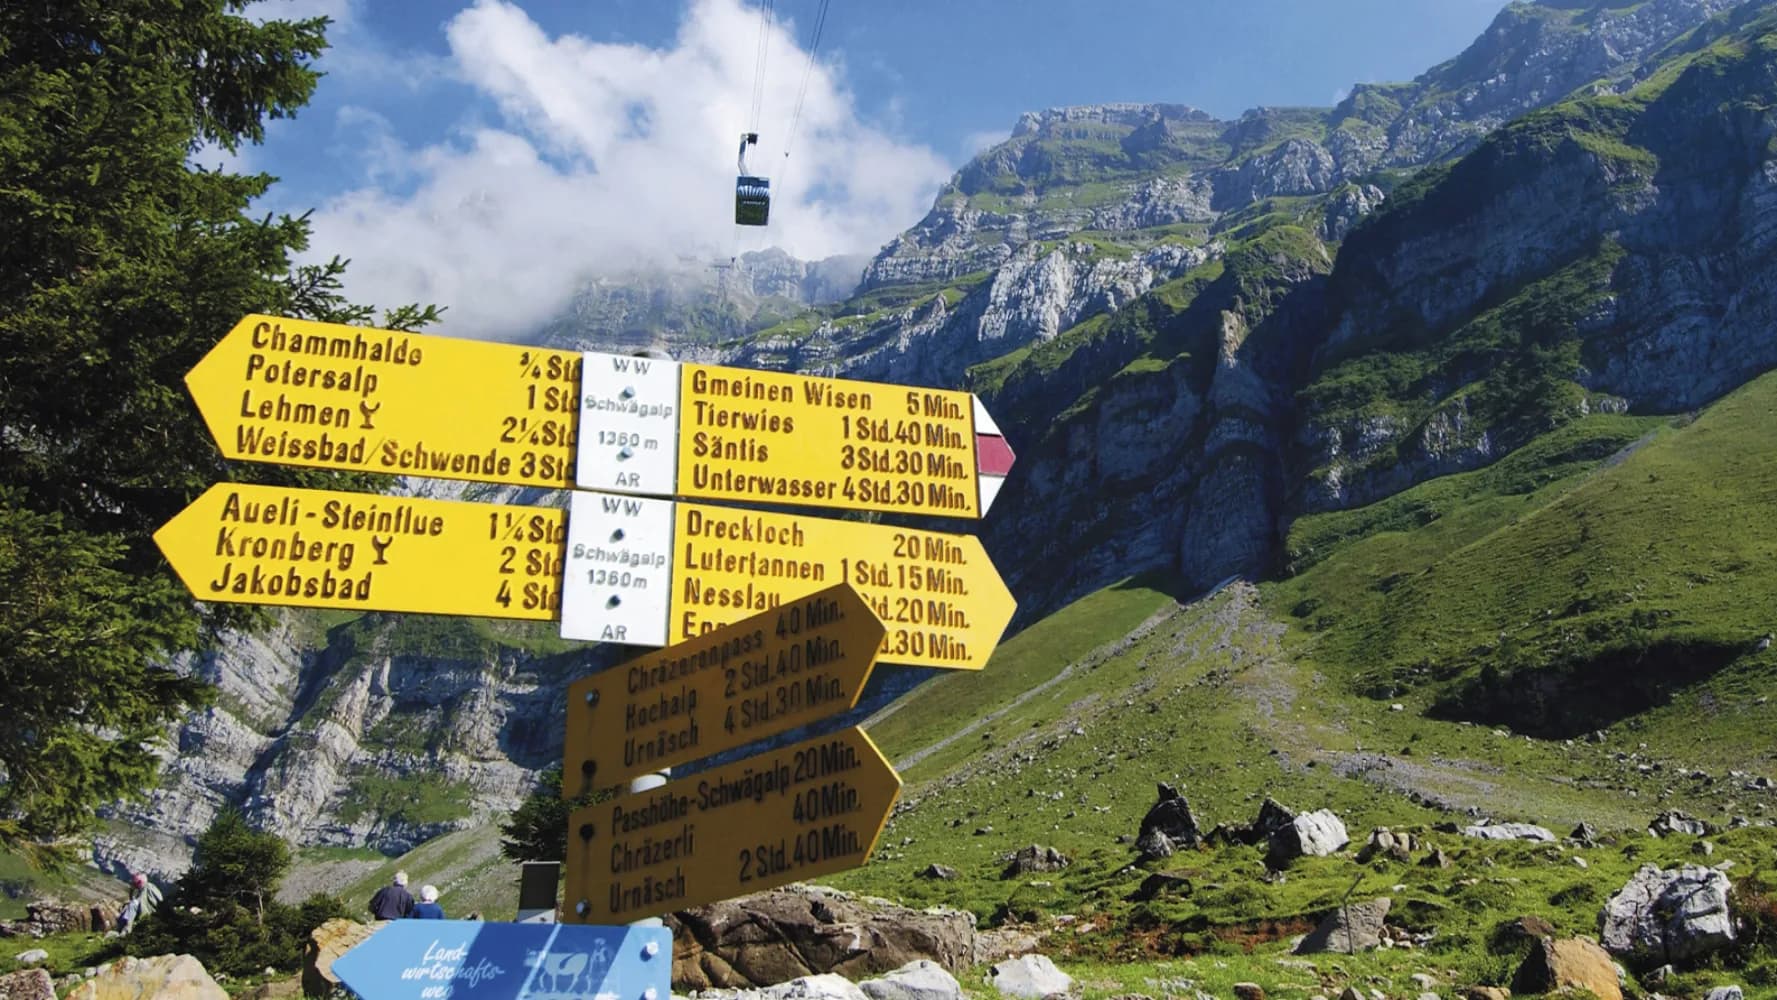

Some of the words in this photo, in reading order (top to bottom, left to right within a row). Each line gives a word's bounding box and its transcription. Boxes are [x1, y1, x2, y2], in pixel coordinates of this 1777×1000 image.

[252, 322, 422, 366] Chammhalde
[246, 354, 377, 397] Potersalp
[693, 369, 794, 403] Gmeinen
[804, 380, 872, 411] Wisen
[241, 389, 350, 428] Lehmen
[693, 400, 794, 434] Tierwies
[907, 391, 920, 415] 5
[924, 394, 964, 420] Min.
[693, 431, 769, 462] Säntis
[926, 423, 967, 450] Min.
[615, 472, 641, 488] AR
[693, 463, 837, 499] Unterwasser
[928, 452, 968, 479] Min.
[928, 483, 971, 511] Min.
[687, 509, 804, 547] Dreckloch
[215, 526, 355, 572] Kronberg
[499, 546, 516, 574] 2
[685, 542, 825, 582] Lutertannen
[893, 533, 920, 559] 20
[925, 537, 968, 565] Min.
[210, 562, 372, 601] Jakobsbad
[496, 579, 512, 608] 4
[684, 577, 780, 610] Nesslau
[926, 567, 969, 596] Min.
[775, 606, 800, 638] 40
[806, 598, 845, 629] Min.
[927, 600, 970, 628] Min.
[601, 624, 628, 641] AR
[929, 633, 972, 661] Min.
[806, 635, 845, 669] Min.
[806, 673, 845, 706] Min.
[623, 721, 698, 768] Urnäsch
[794, 747, 817, 783] 20
[820, 744, 861, 777] Min.
[793, 787, 817, 825] 40
[822, 783, 862, 817] Min.
[610, 824, 694, 875] Chräzerli
[822, 822, 863, 856] Min.
[609, 868, 685, 914] Urnäsch
